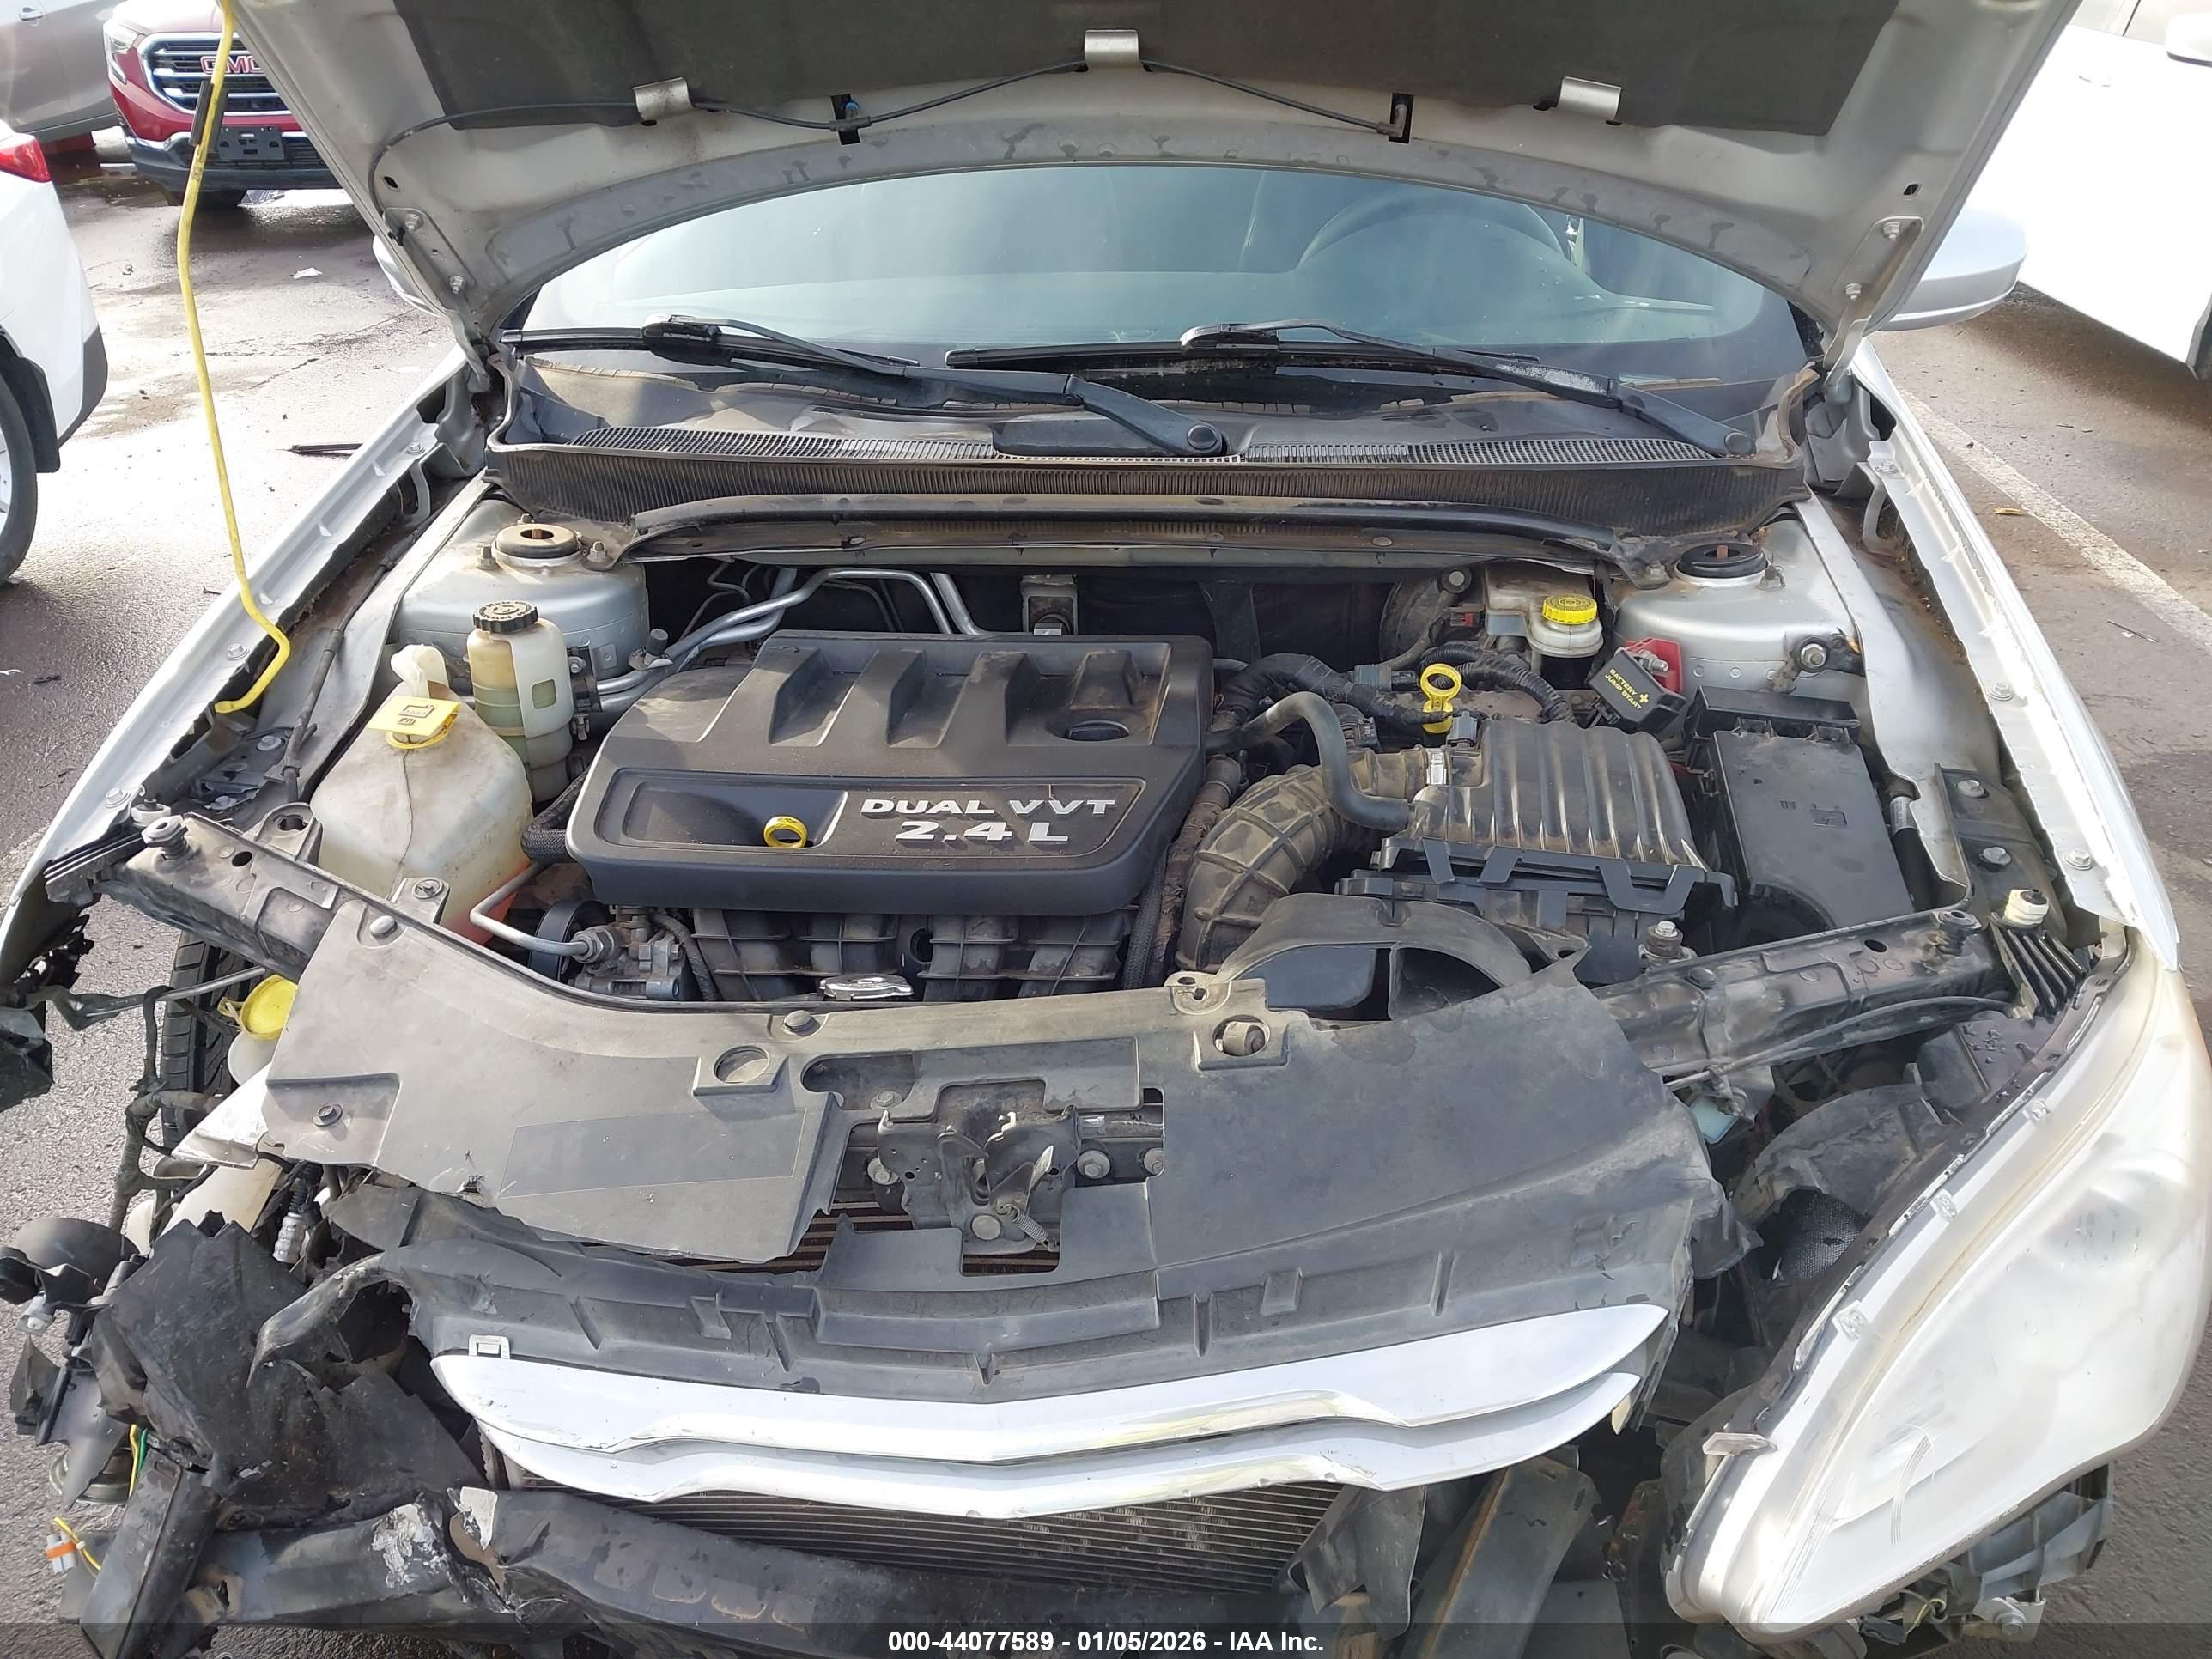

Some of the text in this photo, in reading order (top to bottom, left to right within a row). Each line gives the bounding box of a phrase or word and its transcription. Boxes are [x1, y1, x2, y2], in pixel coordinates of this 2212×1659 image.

[1605, 675, 1642, 709] JUMP START
[1610, 669, 1638, 695] BATTERY
[860, 799, 1115, 815] DUAL VVT
